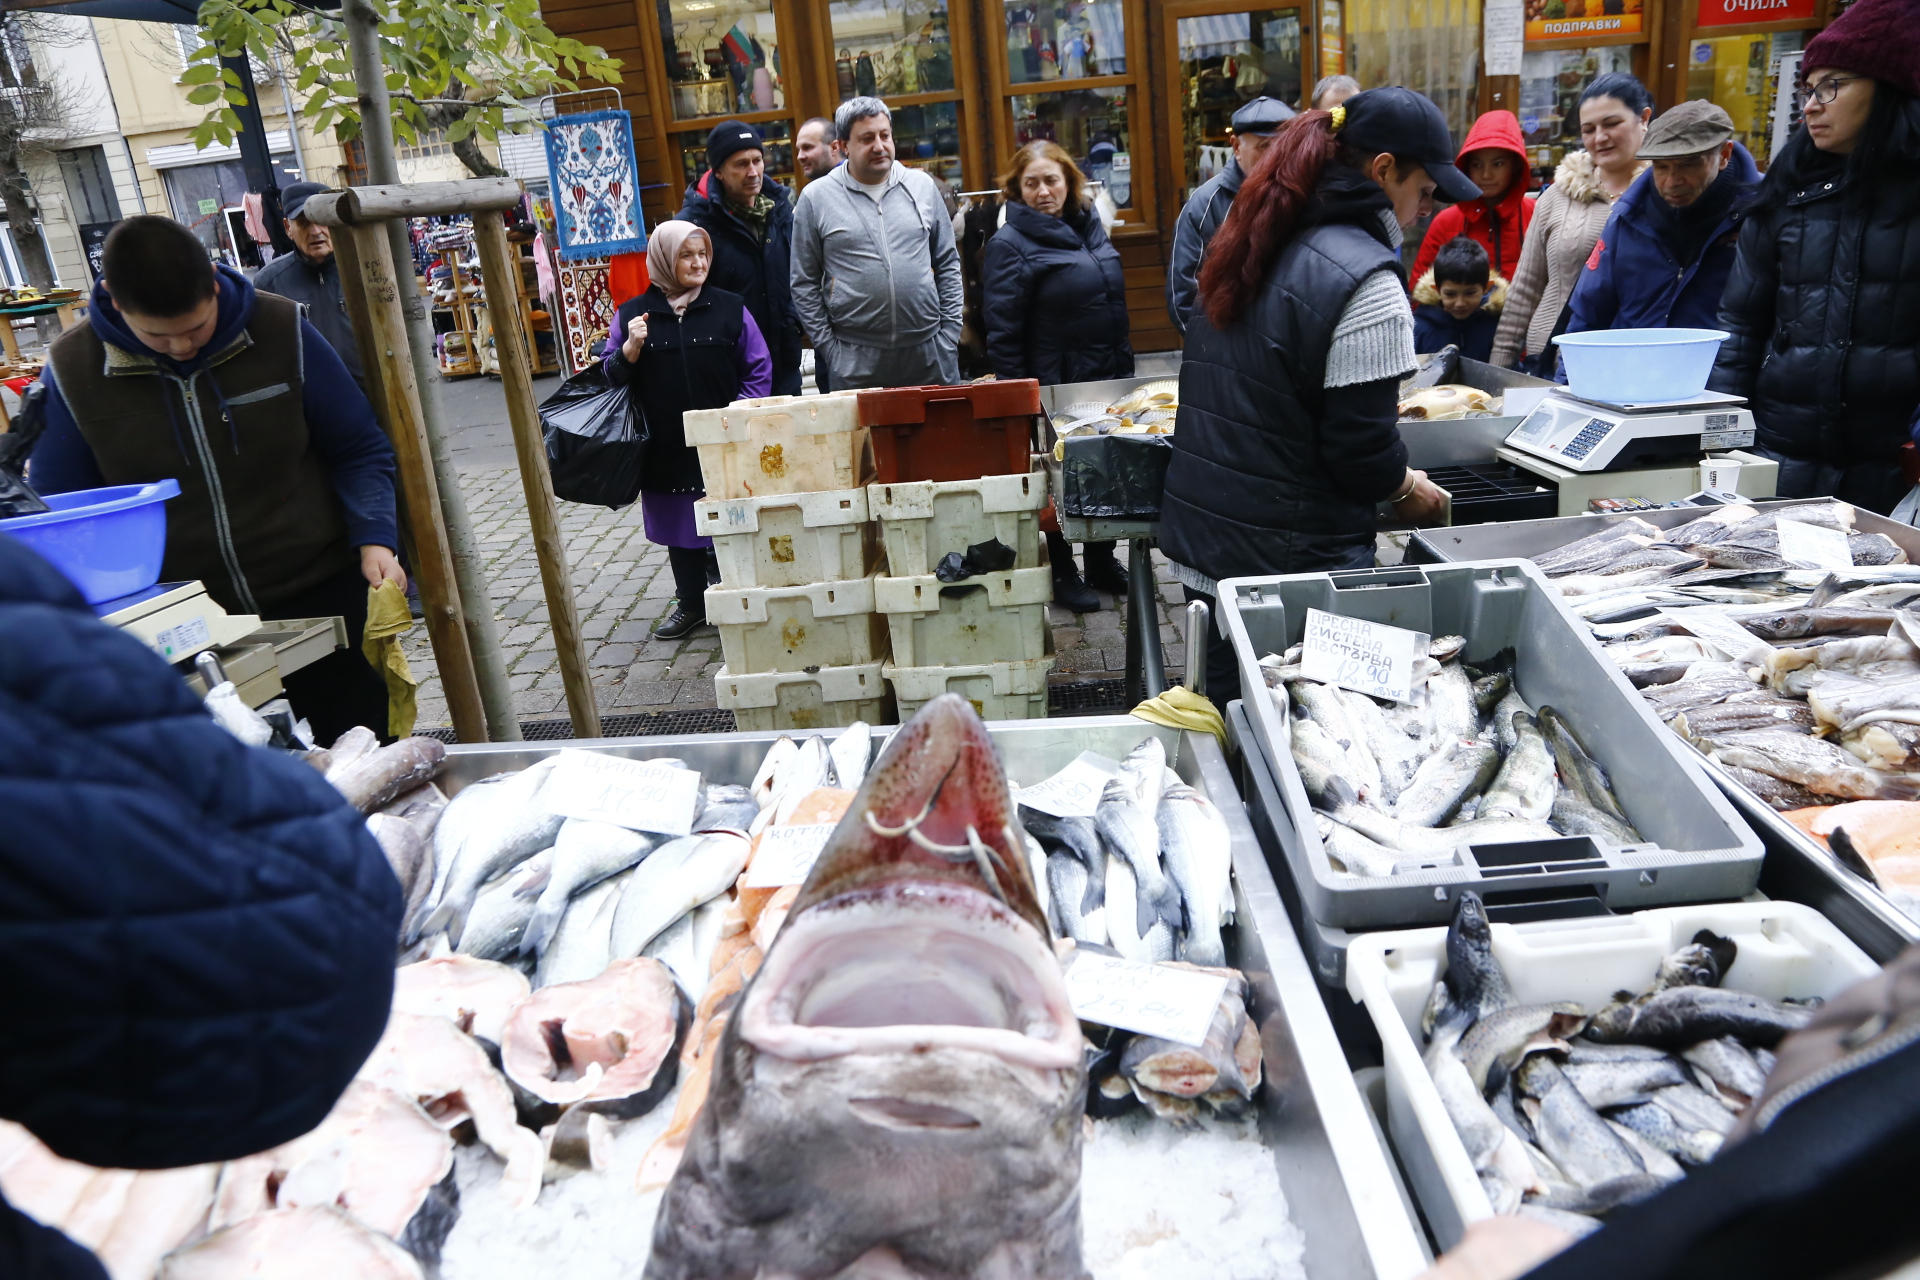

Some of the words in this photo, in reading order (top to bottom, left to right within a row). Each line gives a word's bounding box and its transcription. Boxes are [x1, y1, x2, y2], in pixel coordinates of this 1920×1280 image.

[1544, 19, 1621, 33] ПОДПРАВКИ
[1311, 611, 1371, 636] ПРЕСНА
[1309, 624, 1383, 653] ЧИСТЕНА
[1308, 637, 1392, 671] ПЪСТЪРВА
[1331, 659, 1389, 685] 12,90
[583, 755, 674, 783] ЦИПУРА
